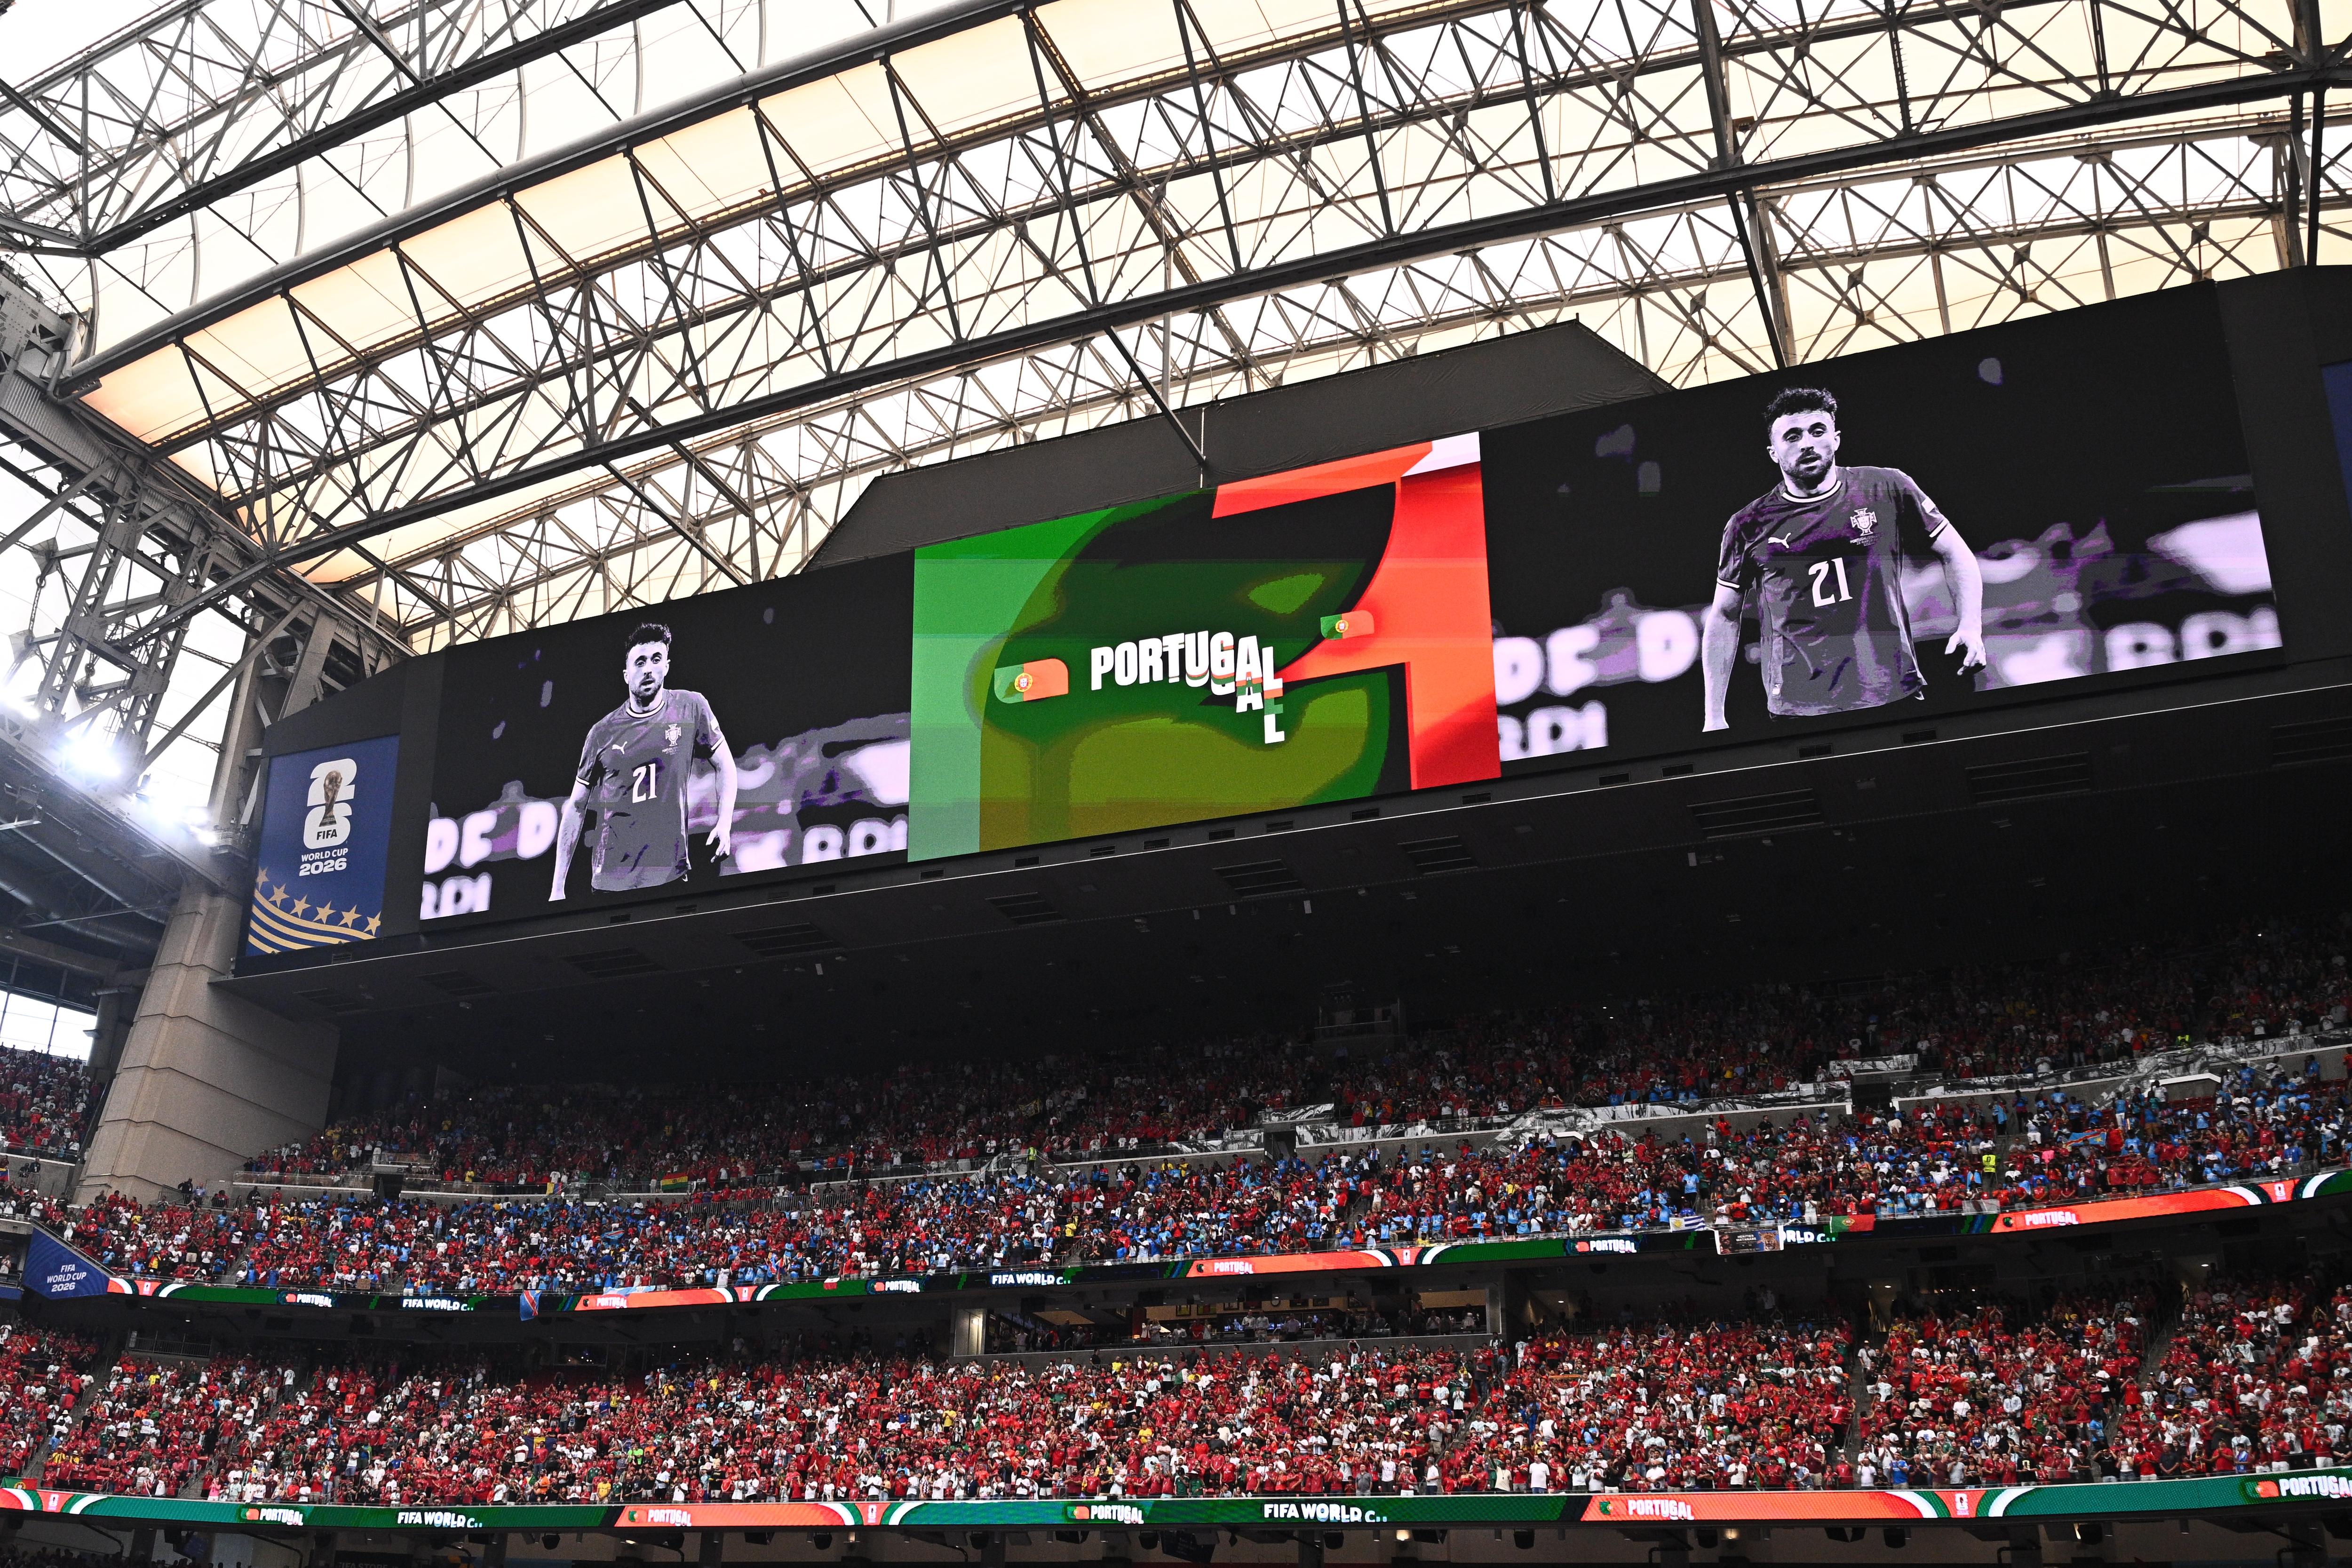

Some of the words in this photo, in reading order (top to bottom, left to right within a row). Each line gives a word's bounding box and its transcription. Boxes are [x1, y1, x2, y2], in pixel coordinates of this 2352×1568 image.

[1808, 557, 1853, 607] 21
[1091, 630, 1285, 713] PORTUGAL
[632, 763, 657, 804] 21
[317, 829, 337, 840] FIFA
[302, 851, 331, 862] WORLD
[332, 848, 349, 857] CUP
[299, 858, 347, 876] 2026
[2025, 1211, 2078, 1226] PORTUGAL
[1783, 1230, 1814, 1243] RLD
[1590, 1239, 1637, 1253] PORTUGAL
[61, 1264, 75, 1273] FIFA
[1214, 1262, 1254, 1274] PORTUGAL
[47, 1274, 71, 1283] WORLD
[72, 1272, 87, 1281] CUP
[992, 1274, 1015, 1285] FIFA
[1016, 1274, 1055, 1286] WORLD
[51, 1282, 75, 1292] 2026
[885, 1281, 920, 1292] PORTUGAL
[297, 1293, 332, 1307] PORTUGAL
[403, 1299, 422, 1308] FIFA
[425, 1299, 460, 1311] WORLD
[596, 1297, 628, 1308] PORTUGAL
[1834, 1409, 1839, 1418] 7
[1091, 1505, 1144, 1524] PORTUGAL
[1264, 1504, 1299, 1519] FIFA
[1301, 1503, 1362, 1522] WORLD
[1628, 1499, 1694, 1520] PORTUGAL
[260, 1508, 303, 1526] PORTUGAL
[397, 1512, 422, 1524] FIFA
[424, 1512, 465, 1528] WORLD
[648, 1509, 692, 1526] PORTUGAL
